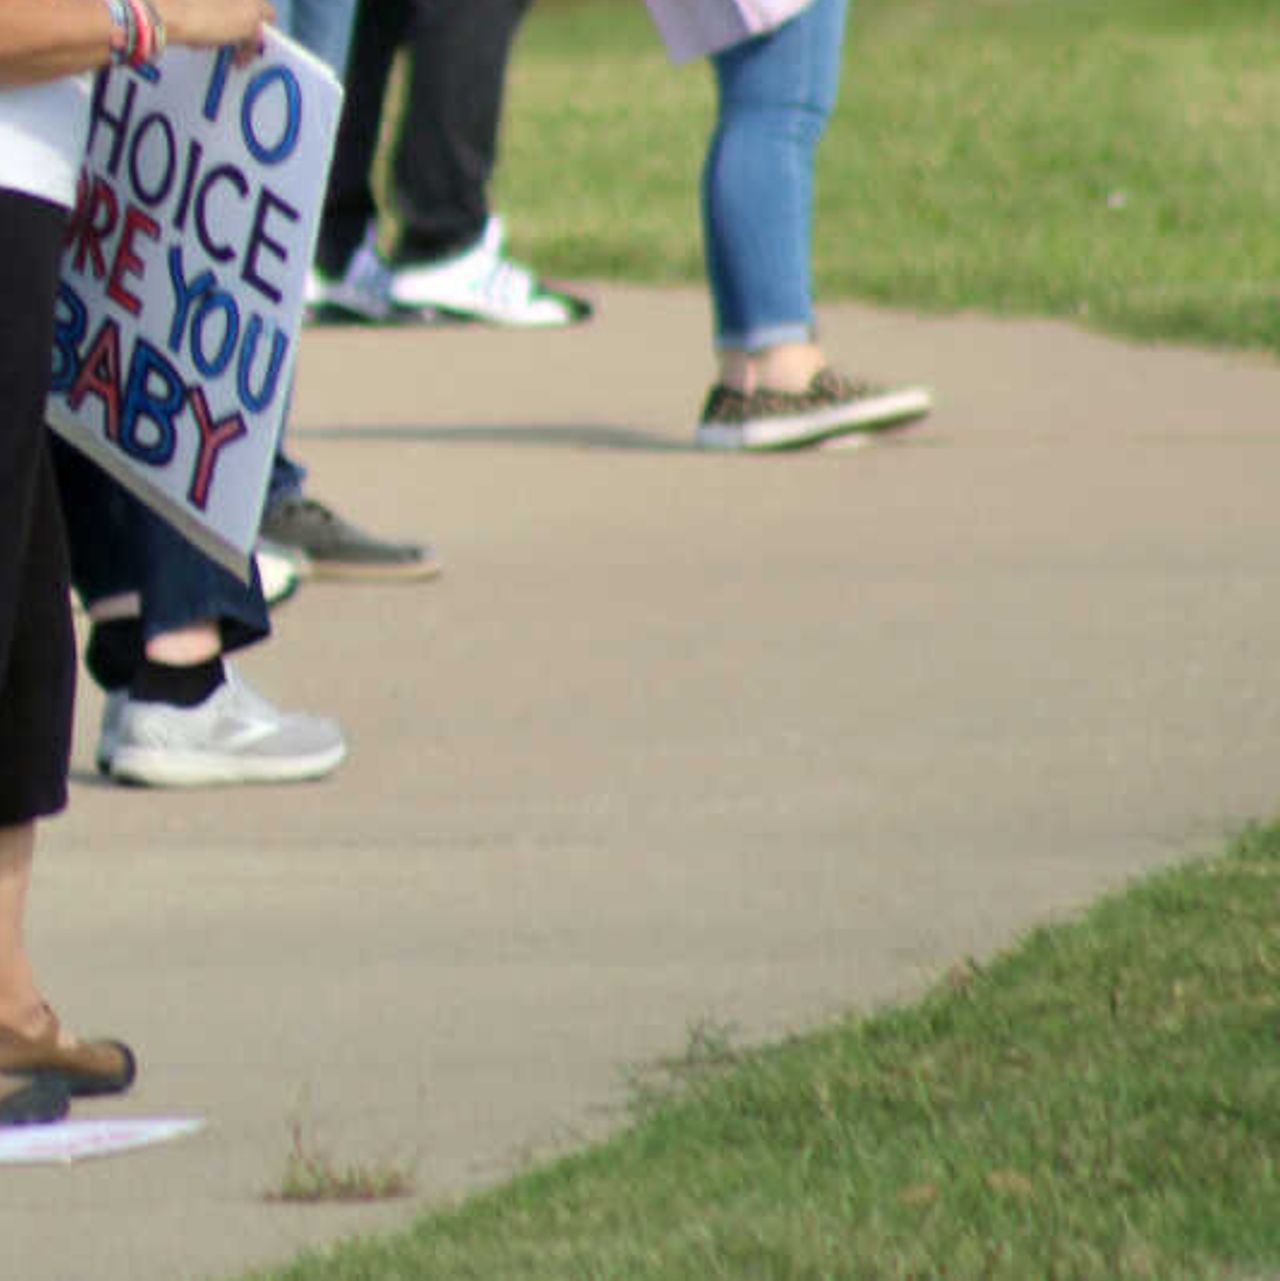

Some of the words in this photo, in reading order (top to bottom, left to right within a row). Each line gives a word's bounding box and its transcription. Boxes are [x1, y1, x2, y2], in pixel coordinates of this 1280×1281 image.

[87, 61, 301, 305] HOICE
[48, 275, 248, 514] BABY
[168, 243, 289, 416] YOU
